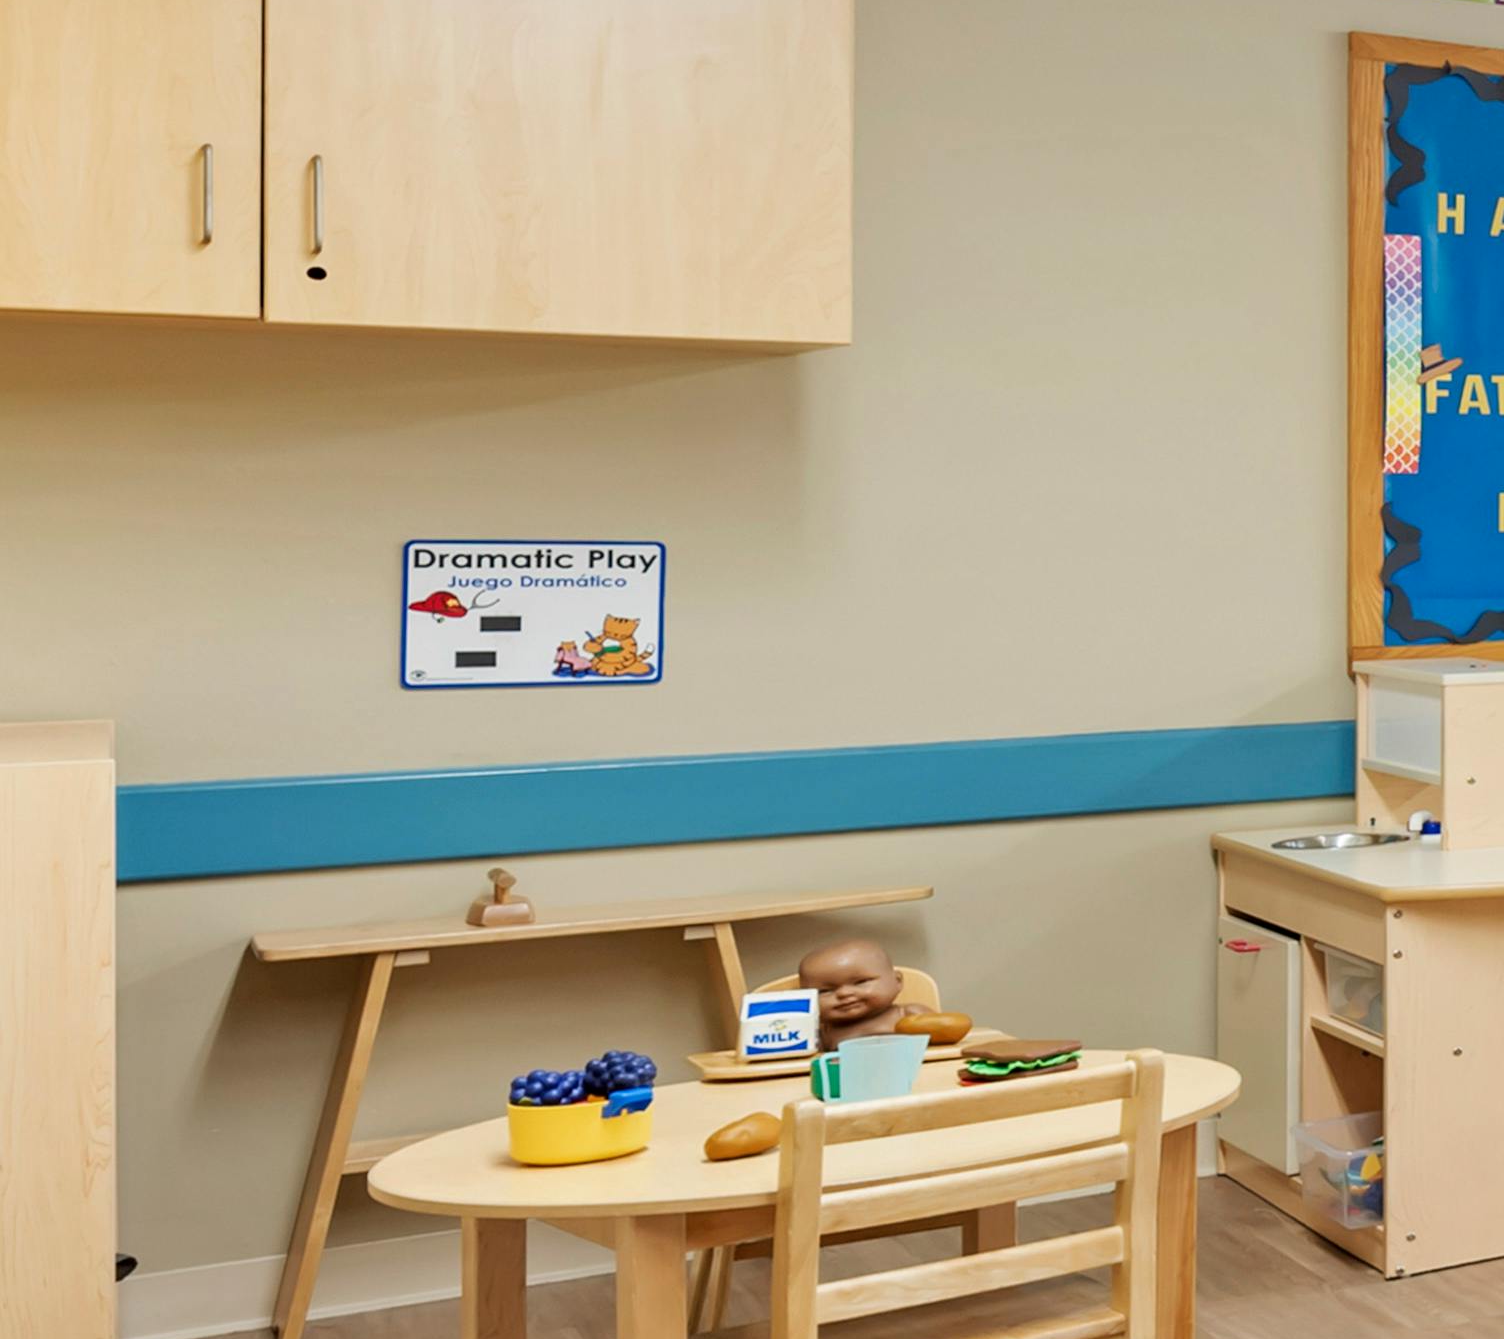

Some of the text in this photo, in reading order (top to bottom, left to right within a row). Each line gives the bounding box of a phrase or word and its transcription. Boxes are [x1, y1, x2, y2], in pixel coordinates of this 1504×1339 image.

[413, 548, 657, 574] Dramatic Play
[447, 573, 628, 591] Juego Dramático
[753, 1030, 800, 1045] MILK
